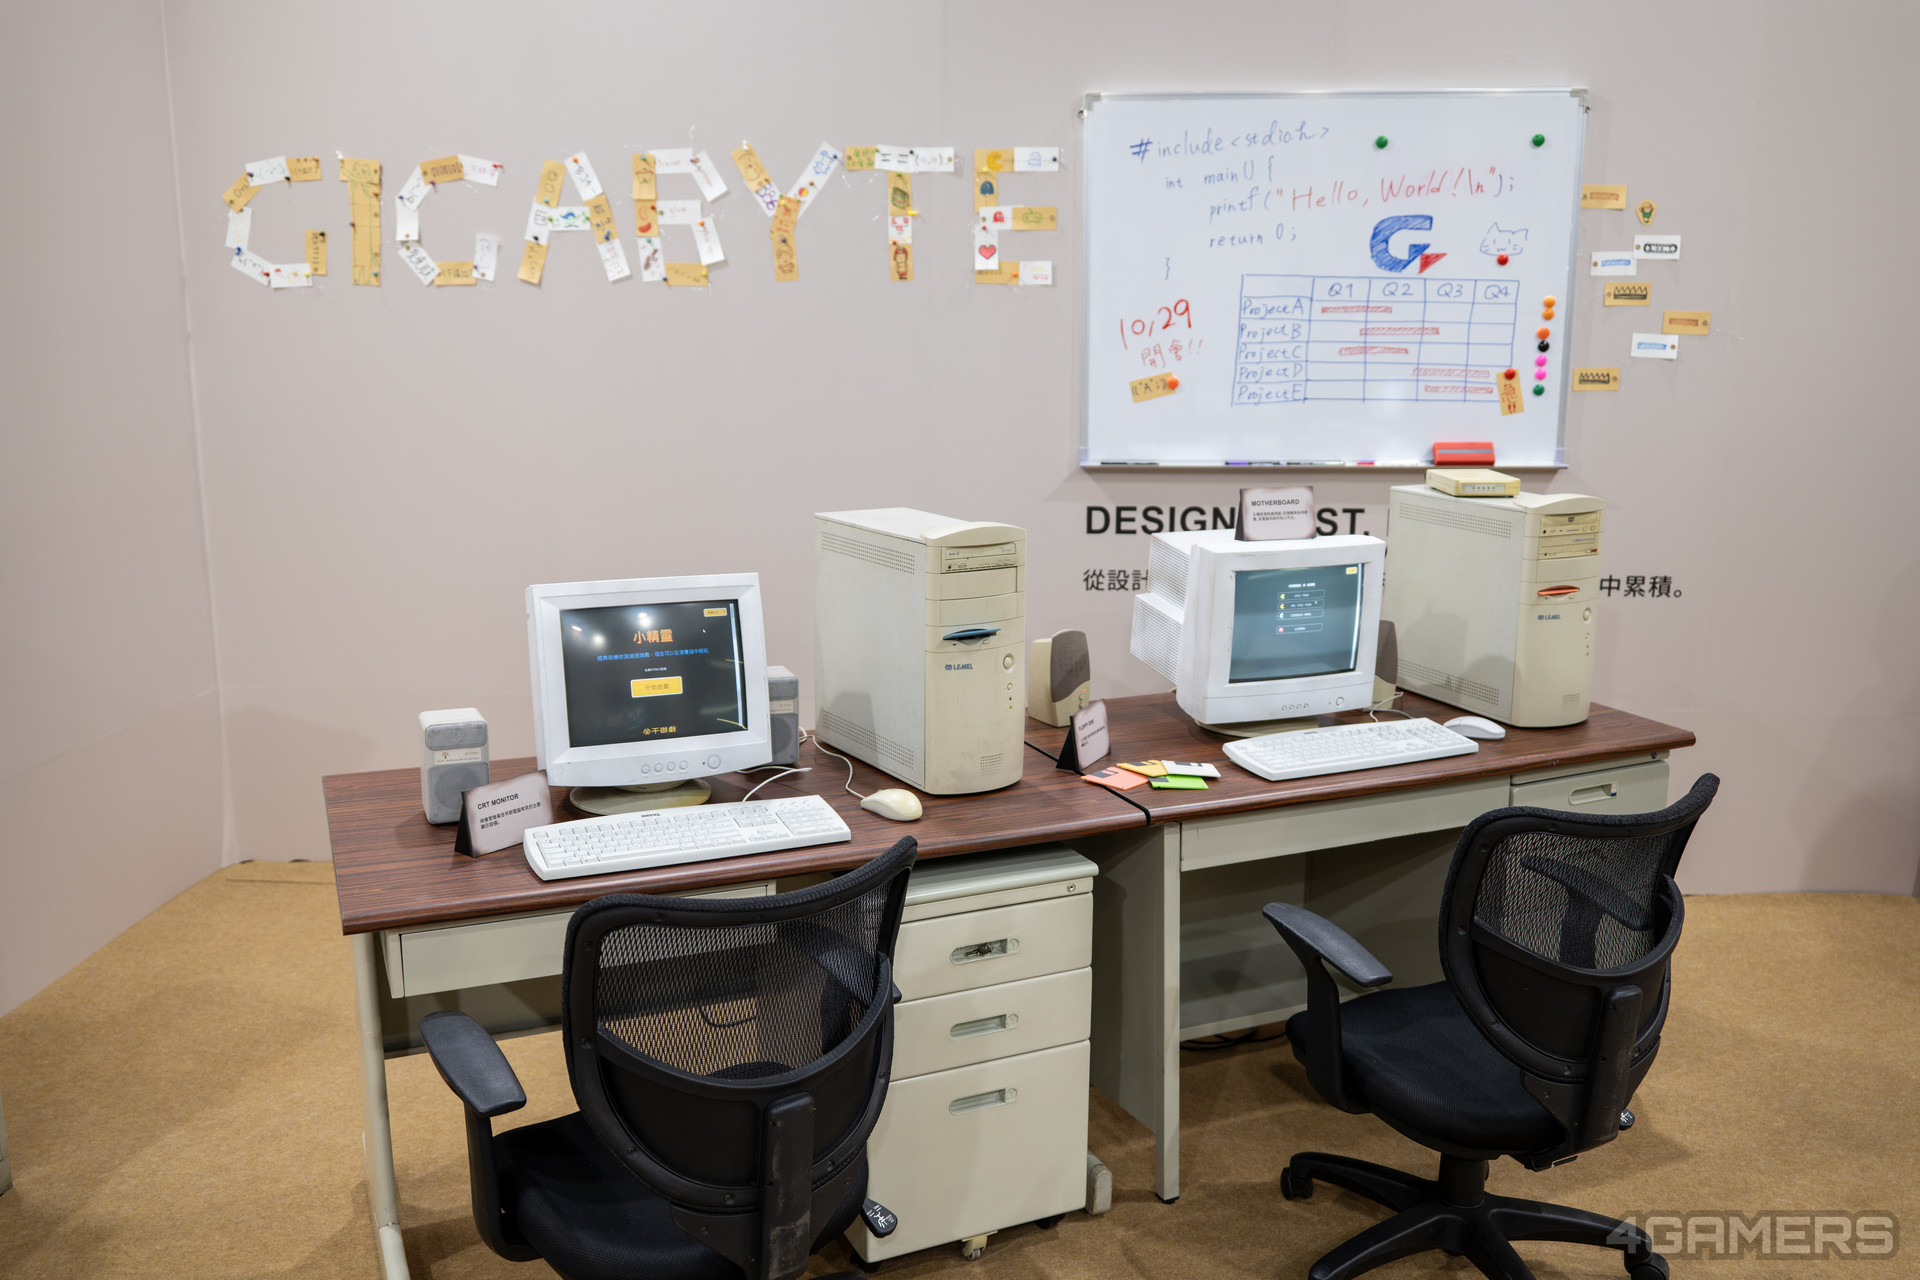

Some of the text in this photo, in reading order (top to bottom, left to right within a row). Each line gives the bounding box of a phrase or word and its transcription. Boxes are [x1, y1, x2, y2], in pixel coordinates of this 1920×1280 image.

[1165, 176, 1184, 189] int
[1209, 231, 1264, 248] return
[1328, 281, 1511, 300] Q1 Q2 Q3 Q4
[1251, 498, 1300, 507] MOTHERBOARD
[633, 628, 674, 645] 小精靈
[477, 793, 520, 810] CRT MONITOR
